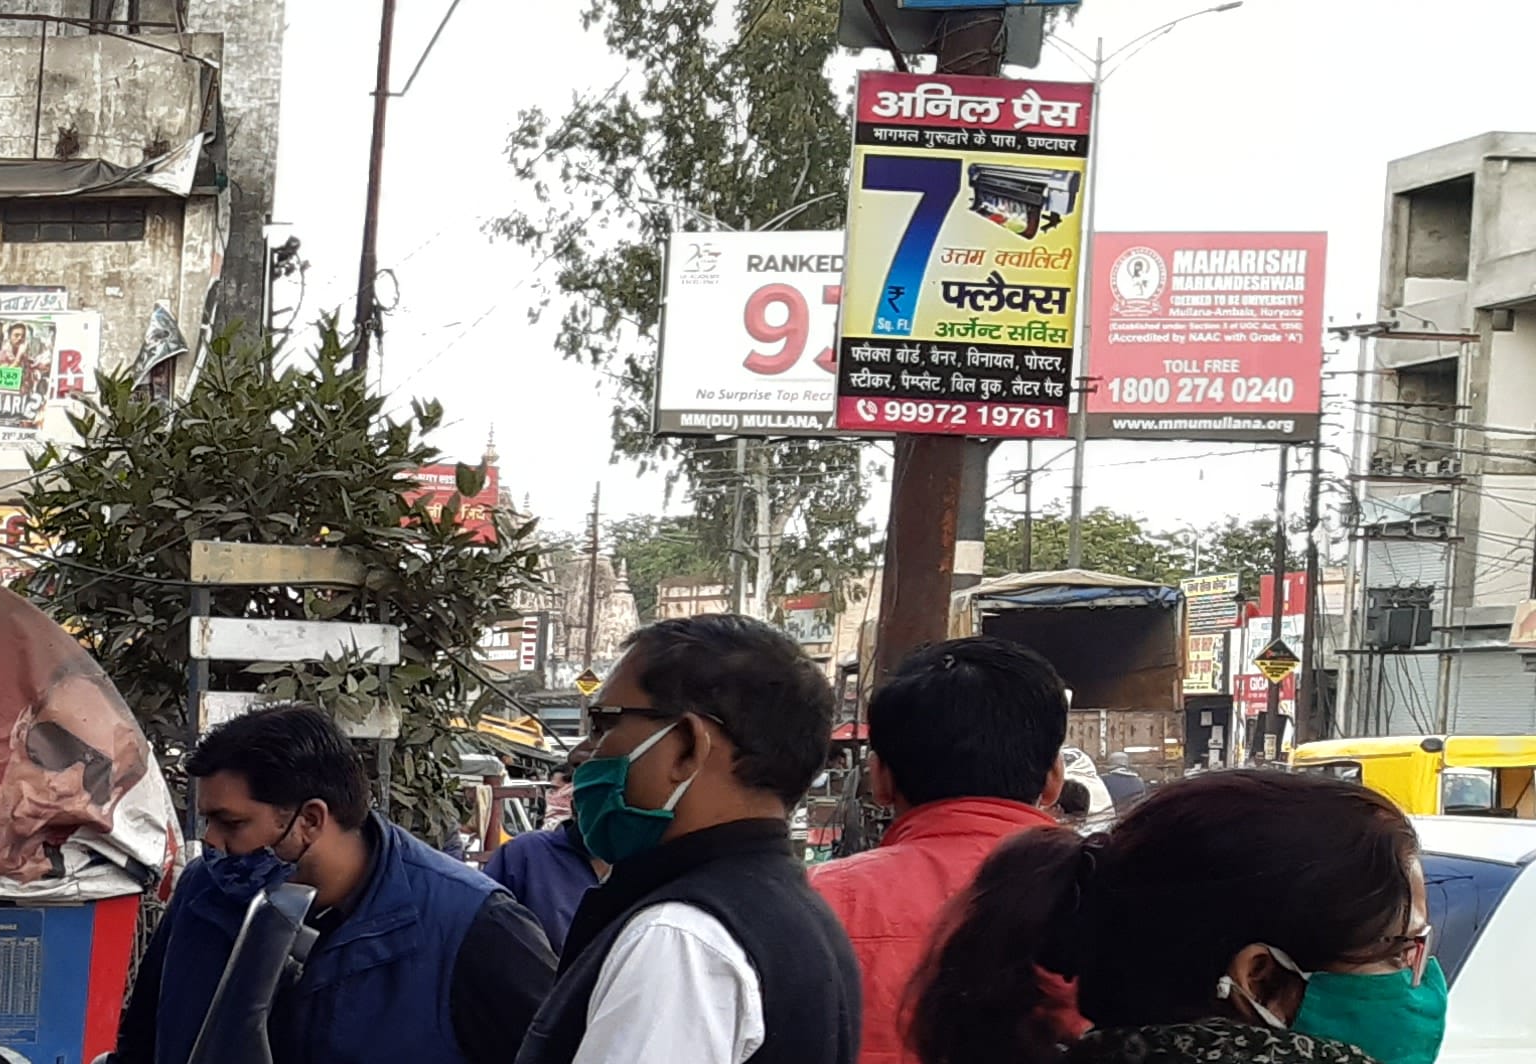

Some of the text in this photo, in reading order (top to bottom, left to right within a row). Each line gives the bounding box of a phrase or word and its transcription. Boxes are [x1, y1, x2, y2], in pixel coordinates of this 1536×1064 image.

[872, 82, 1082, 128] अनिल प्रैस
[873, 128, 919, 143] भागमल
[972, 134, 986, 146] के
[861, 154, 963, 334] 7
[747, 254, 845, 273] RANKED
[940, 246, 1072, 270] उत्तम क्वालिटी
[1172, 250, 1306, 274] MAHARISHI
[941, 270, 1070, 315] फ्लैक्स
[1172, 276, 1305, 291] MARKANDESHWAR
[1214, 295, 1226, 305] TO
[1261, 308, 1303, 318] Haryana
[1007, 320, 1068, 343] सर्विस
[1108, 333, 1281, 345] (Accredited by NAAC with Grade
[1163, 360, 1240, 373] TOLL FREE
[696, 389, 715, 400] No
[719, 389, 772, 402] Surprise
[776, 390, 799, 402] Top
[1108, 378, 1294, 404] 1800 274 0240
[680, 413, 738, 430] MM(DU)
[884, 402, 1055, 428] 99972 19761
[1113, 418, 1295, 433] www.mmumullana.org
